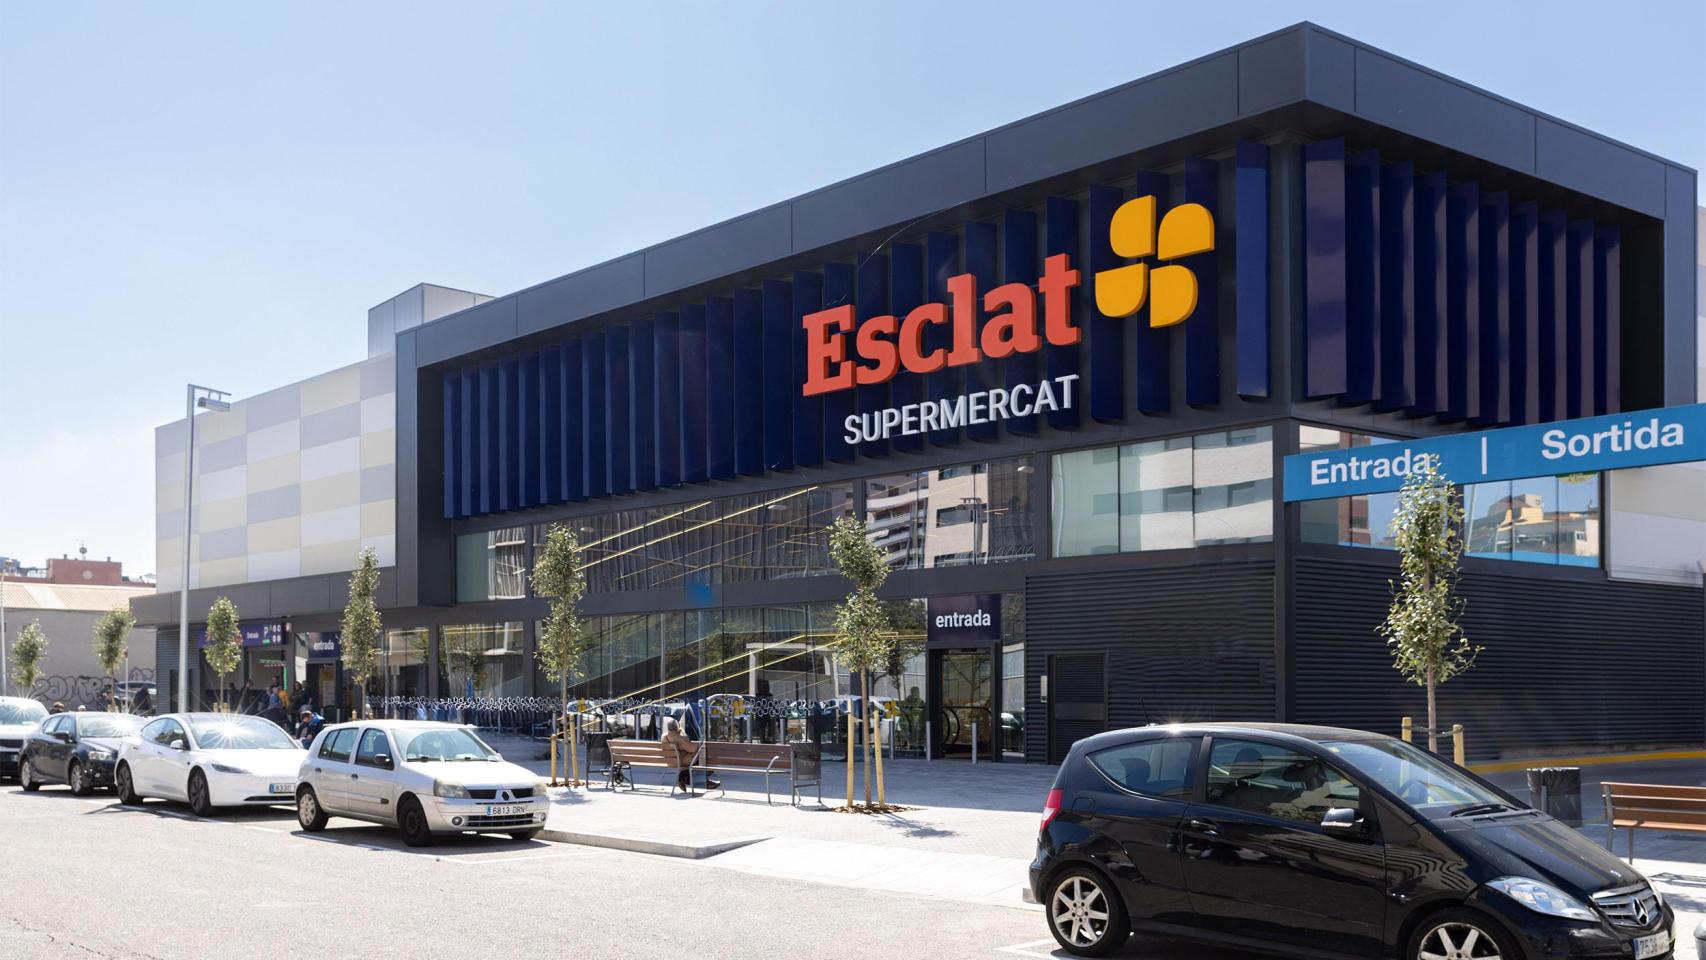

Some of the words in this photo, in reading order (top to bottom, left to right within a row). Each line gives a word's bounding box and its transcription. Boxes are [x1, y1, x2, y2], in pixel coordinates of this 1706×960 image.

[803, 253, 1081, 396] Esclat
[844, 374, 1079, 444] SUPERMERCAT
[1311, 449, 1431, 485] Entrada
[1541, 418, 1684, 460] Sortida
[936, 609, 991, 627] entrada
[492, 806, 510, 815] 6813
